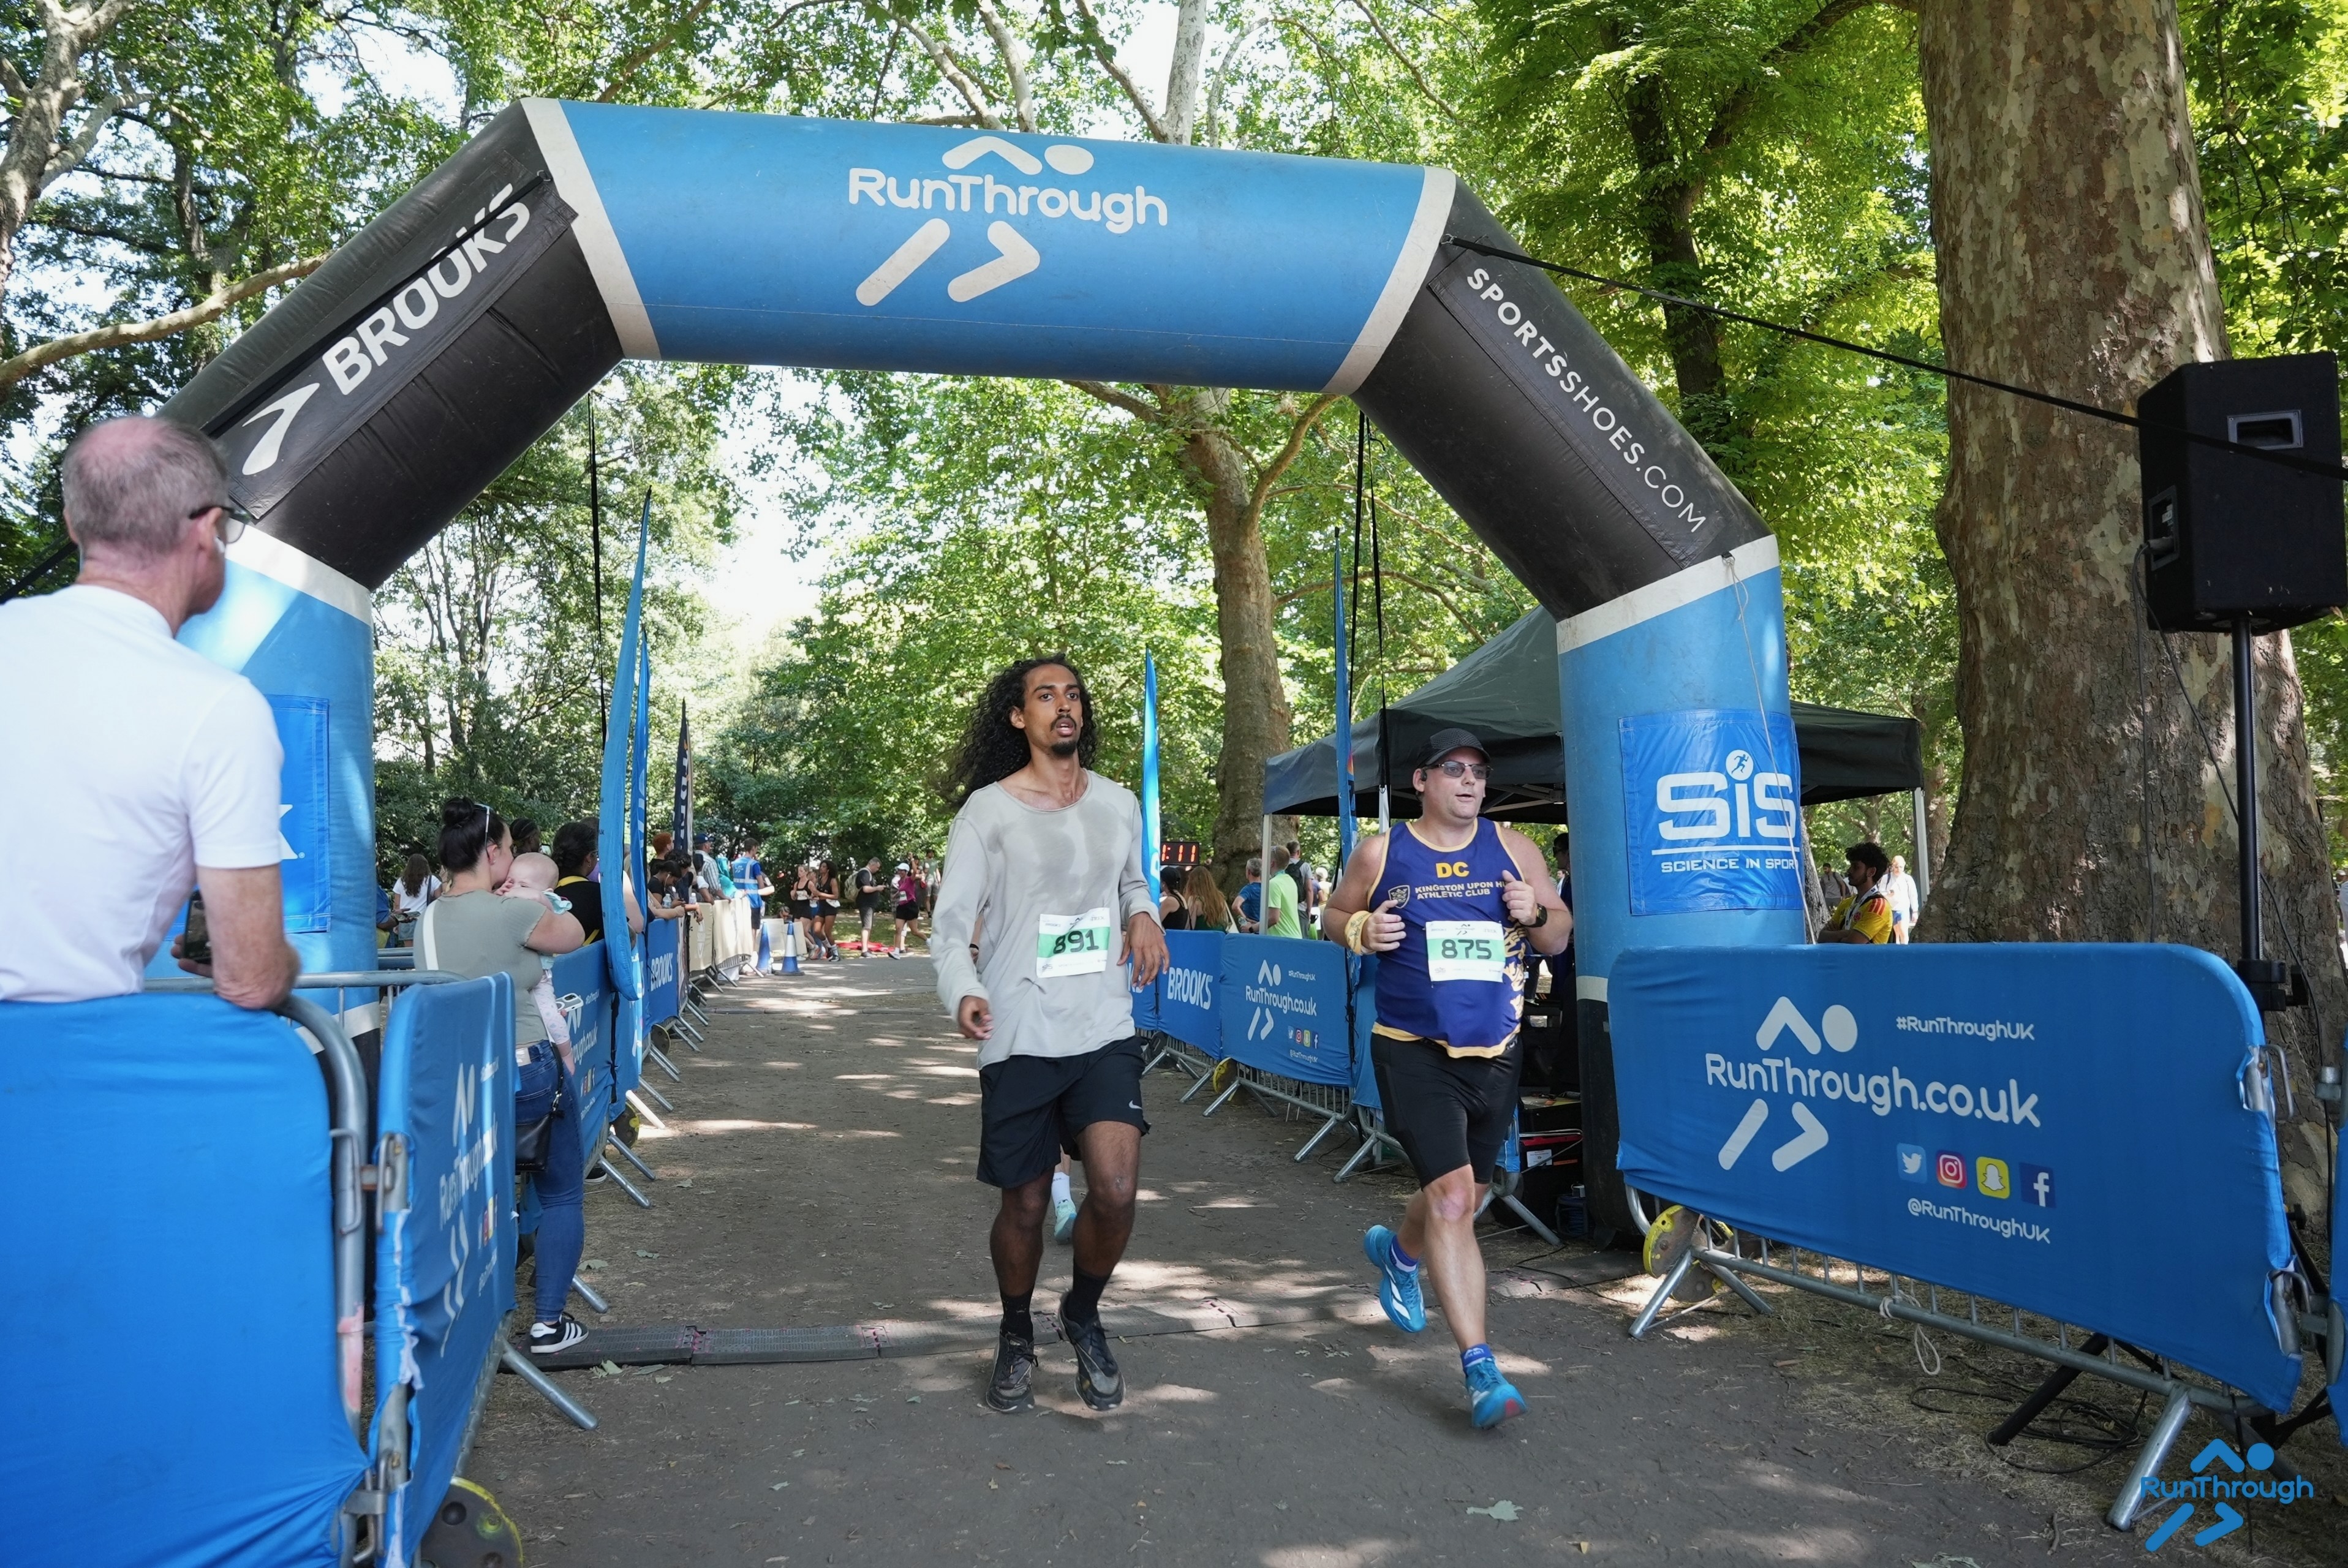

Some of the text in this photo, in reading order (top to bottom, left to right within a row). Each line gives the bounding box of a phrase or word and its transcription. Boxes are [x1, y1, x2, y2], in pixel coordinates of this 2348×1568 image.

[849, 167, 1168, 233] RunThrough
[322, 183, 530, 395] BROOKS
[1467, 268, 1706, 533] SPORTSSHOES.COM
[1436, 861, 1470, 878] DC
[1661, 858, 1798, 873] SCIENCE IN SPOR
[1415, 884, 1465, 894] KINGSTON
[1417, 888, 1490, 900] ATHLETIC CLUB
[1053, 929, 1100, 954] 891
[1441, 939, 1492, 959] 875
[651, 952, 673, 992] BROOKS
[1168, 967, 1213, 1010] BROOKS
[1245, 985, 1316, 1017] RunThrough.co.uk
[1897, 1016, 2034, 1041] #RunThroughUK
[1705, 1052, 2041, 1128] RunThrough.co.uk
[1908, 1197, 2051, 1244] @RunThroughUK
